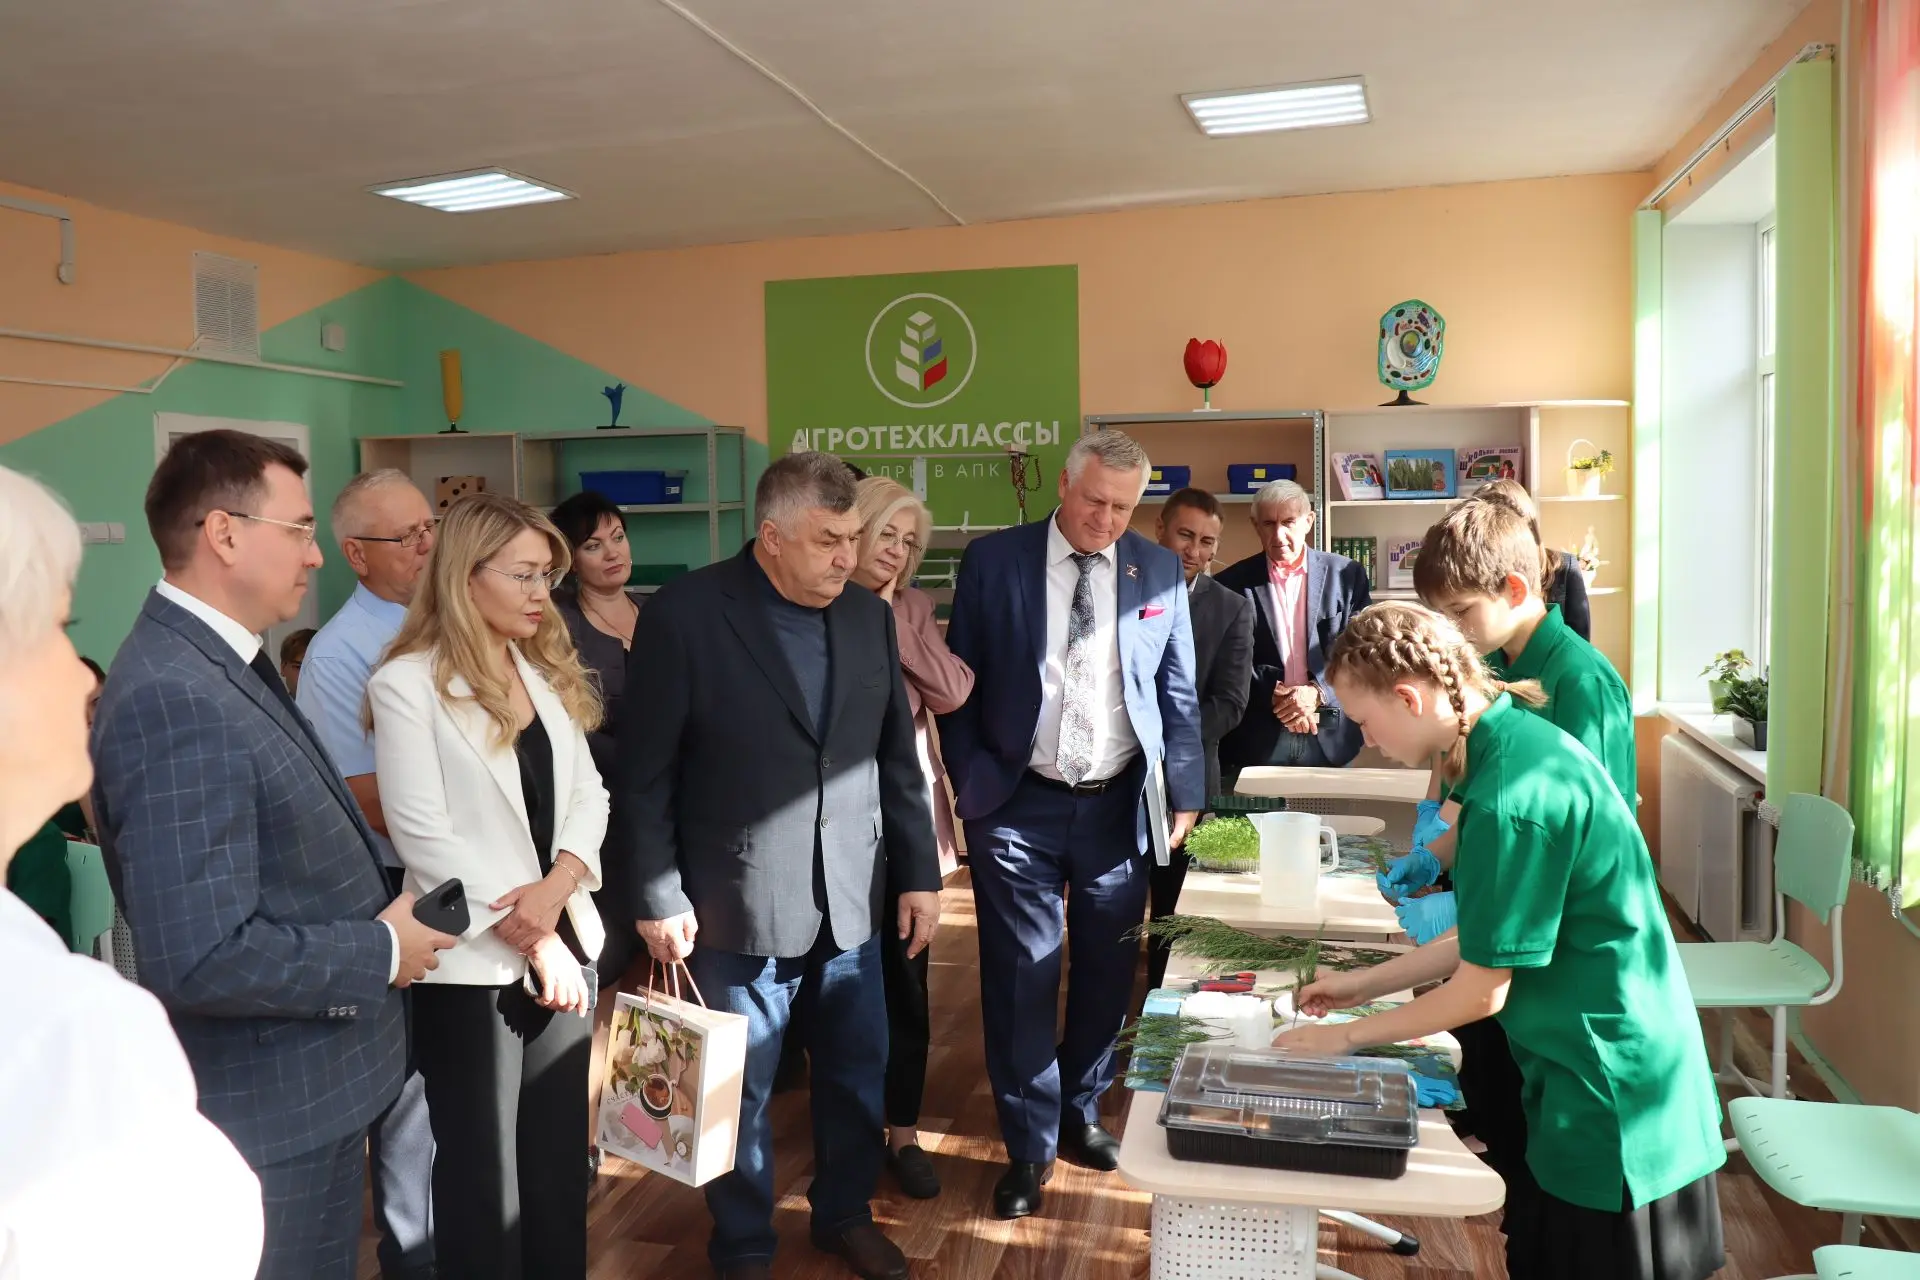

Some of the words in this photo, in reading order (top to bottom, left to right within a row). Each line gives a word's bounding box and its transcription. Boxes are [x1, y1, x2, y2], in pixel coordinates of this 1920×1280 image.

[792, 421, 1059, 452] АГРОТЕХКЛАССЫ
[935, 464, 944, 478] В
[956, 462, 1000, 478] АПК
